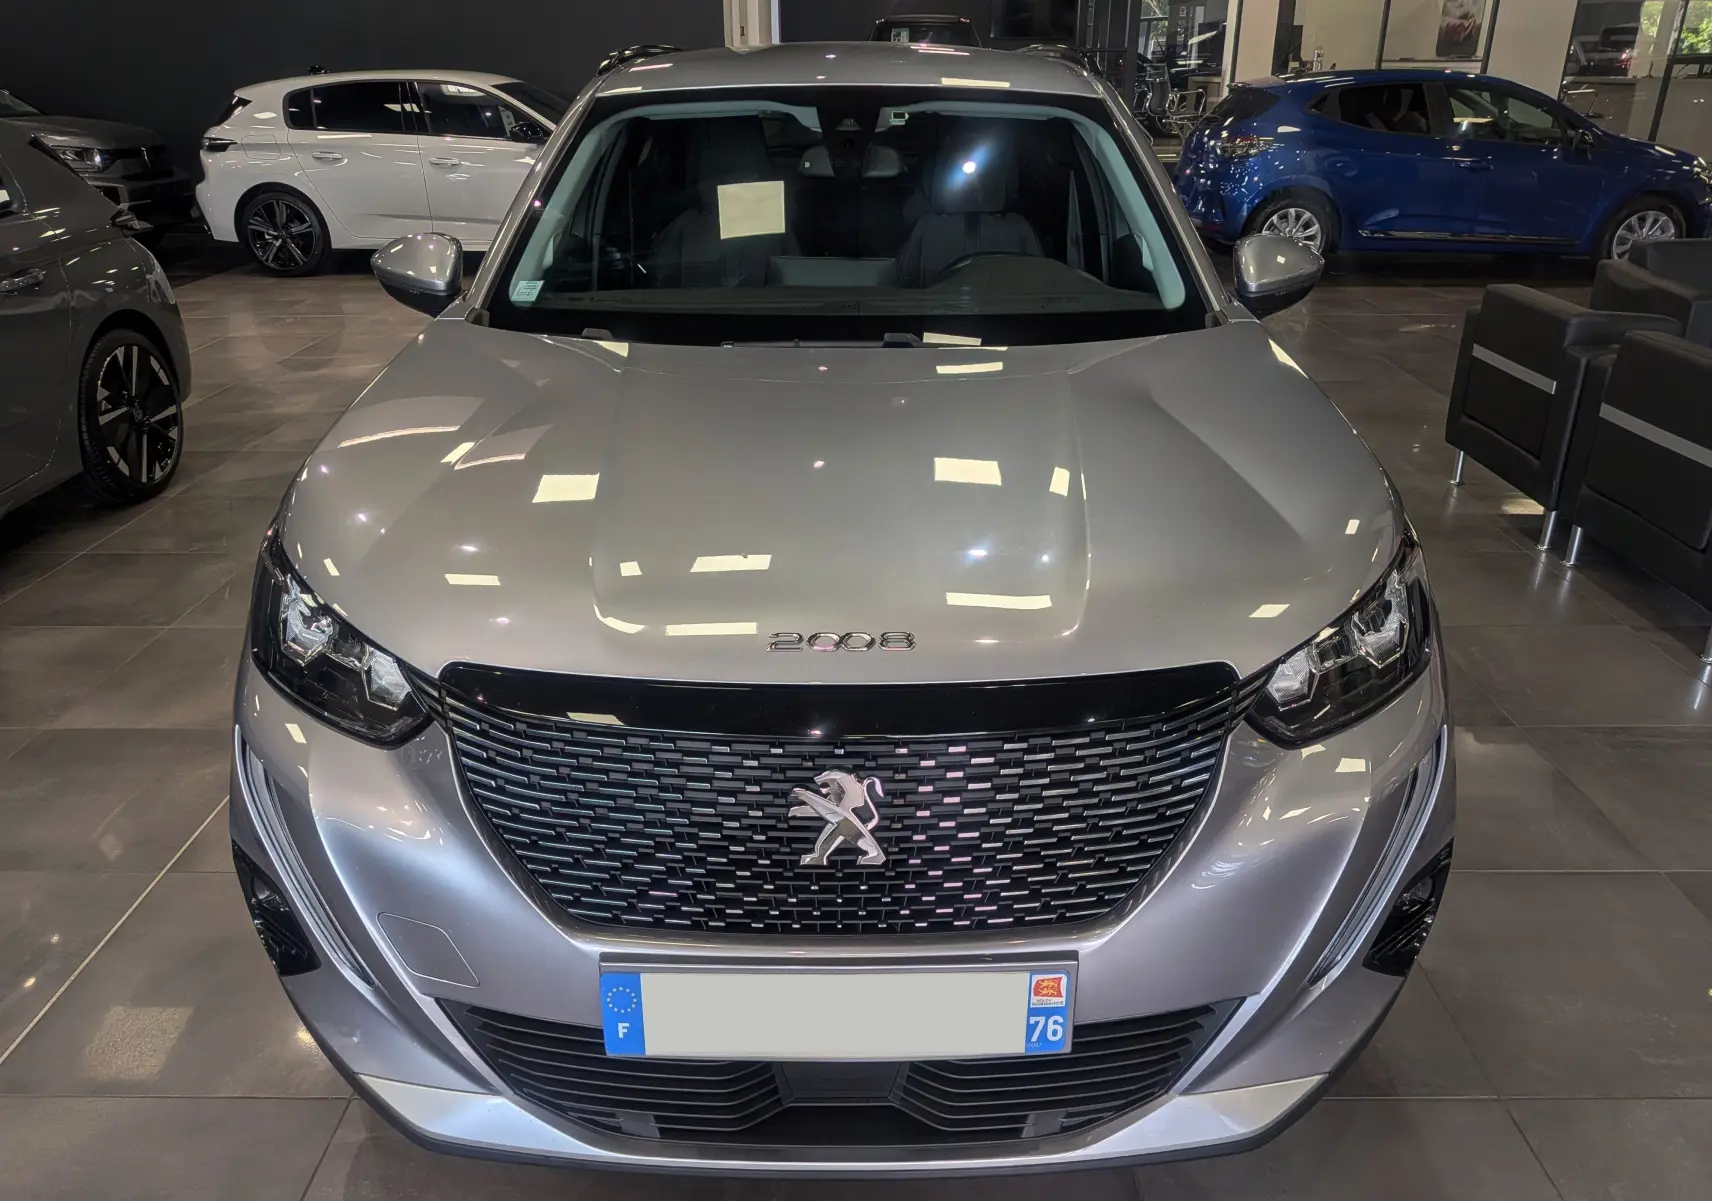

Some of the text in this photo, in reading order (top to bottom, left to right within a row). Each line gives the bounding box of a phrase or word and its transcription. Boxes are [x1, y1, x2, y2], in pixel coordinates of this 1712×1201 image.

[767, 631, 917, 652] 2008
[617, 1022, 629, 1039] F
[1029, 1015, 1064, 1042] 76
